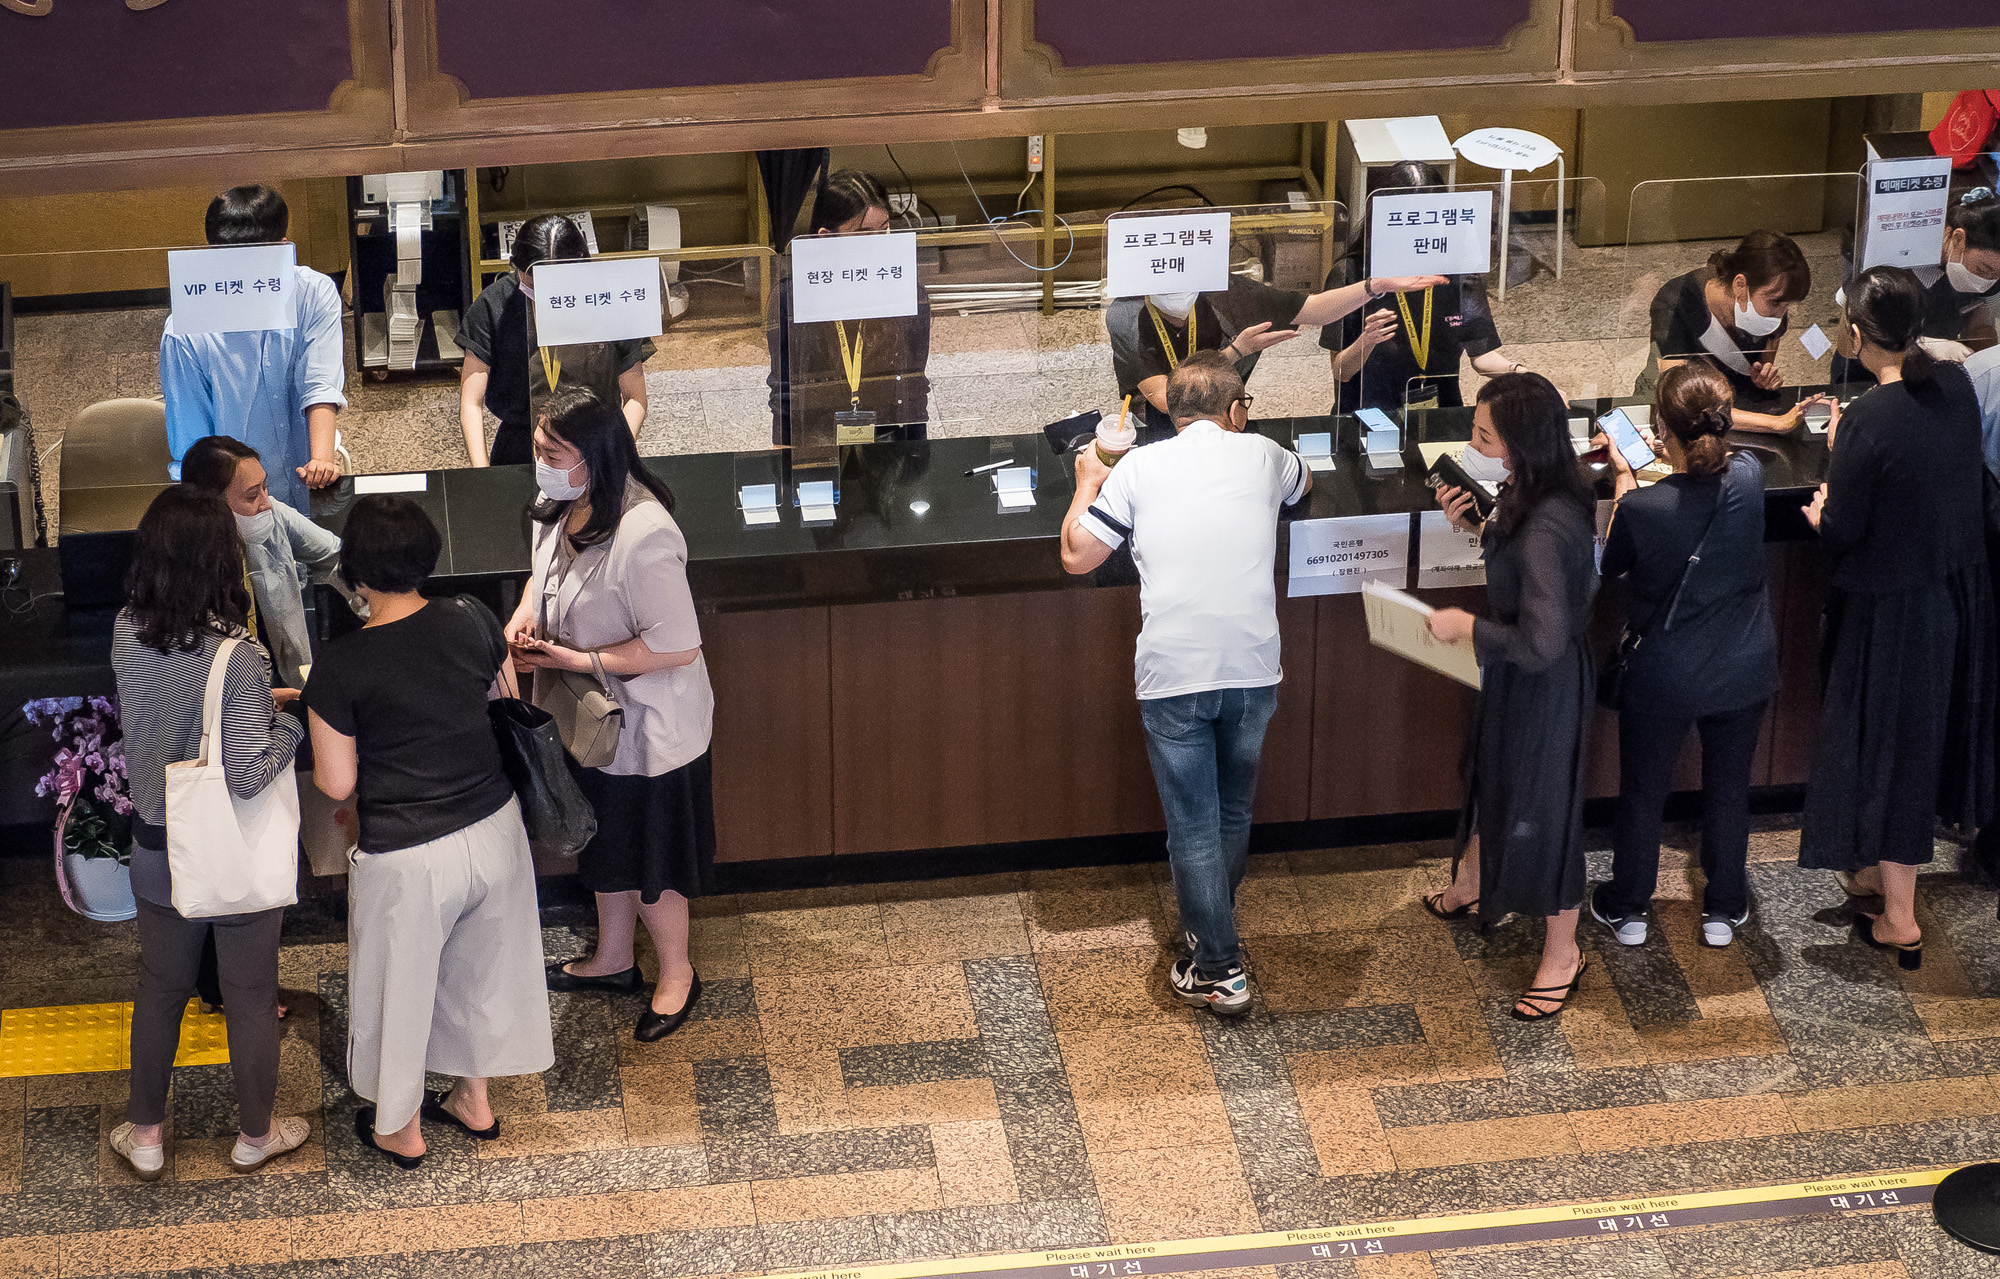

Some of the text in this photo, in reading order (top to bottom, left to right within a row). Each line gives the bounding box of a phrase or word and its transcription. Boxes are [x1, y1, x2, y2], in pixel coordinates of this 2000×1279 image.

[1879, 176, 1943, 191] 예매티켓 수령
[1387, 208, 1476, 226] 프로그램북
[1123, 229, 1214, 248] 프로그램북
[1413, 236, 1448, 254] 판매
[1150, 256, 1185, 274] 판매
[806, 266, 902, 284] 현장 티켓 수령
[184, 278, 281, 296] VIP 티켓 수령
[549, 288, 646, 309] 현장 티켓 수령
[1332, 539, 1364, 549] 국민은행
[1306, 550, 1389, 565] 66910201497305
[1803, 1176, 1908, 1193] Please wait here
[1572, 1199, 1679, 1216] Please wait here
[1287, 1225, 1395, 1241] Please wait here
[1046, 1246, 1156, 1261] Please wait here
[831, 1271, 861, 1279] here
